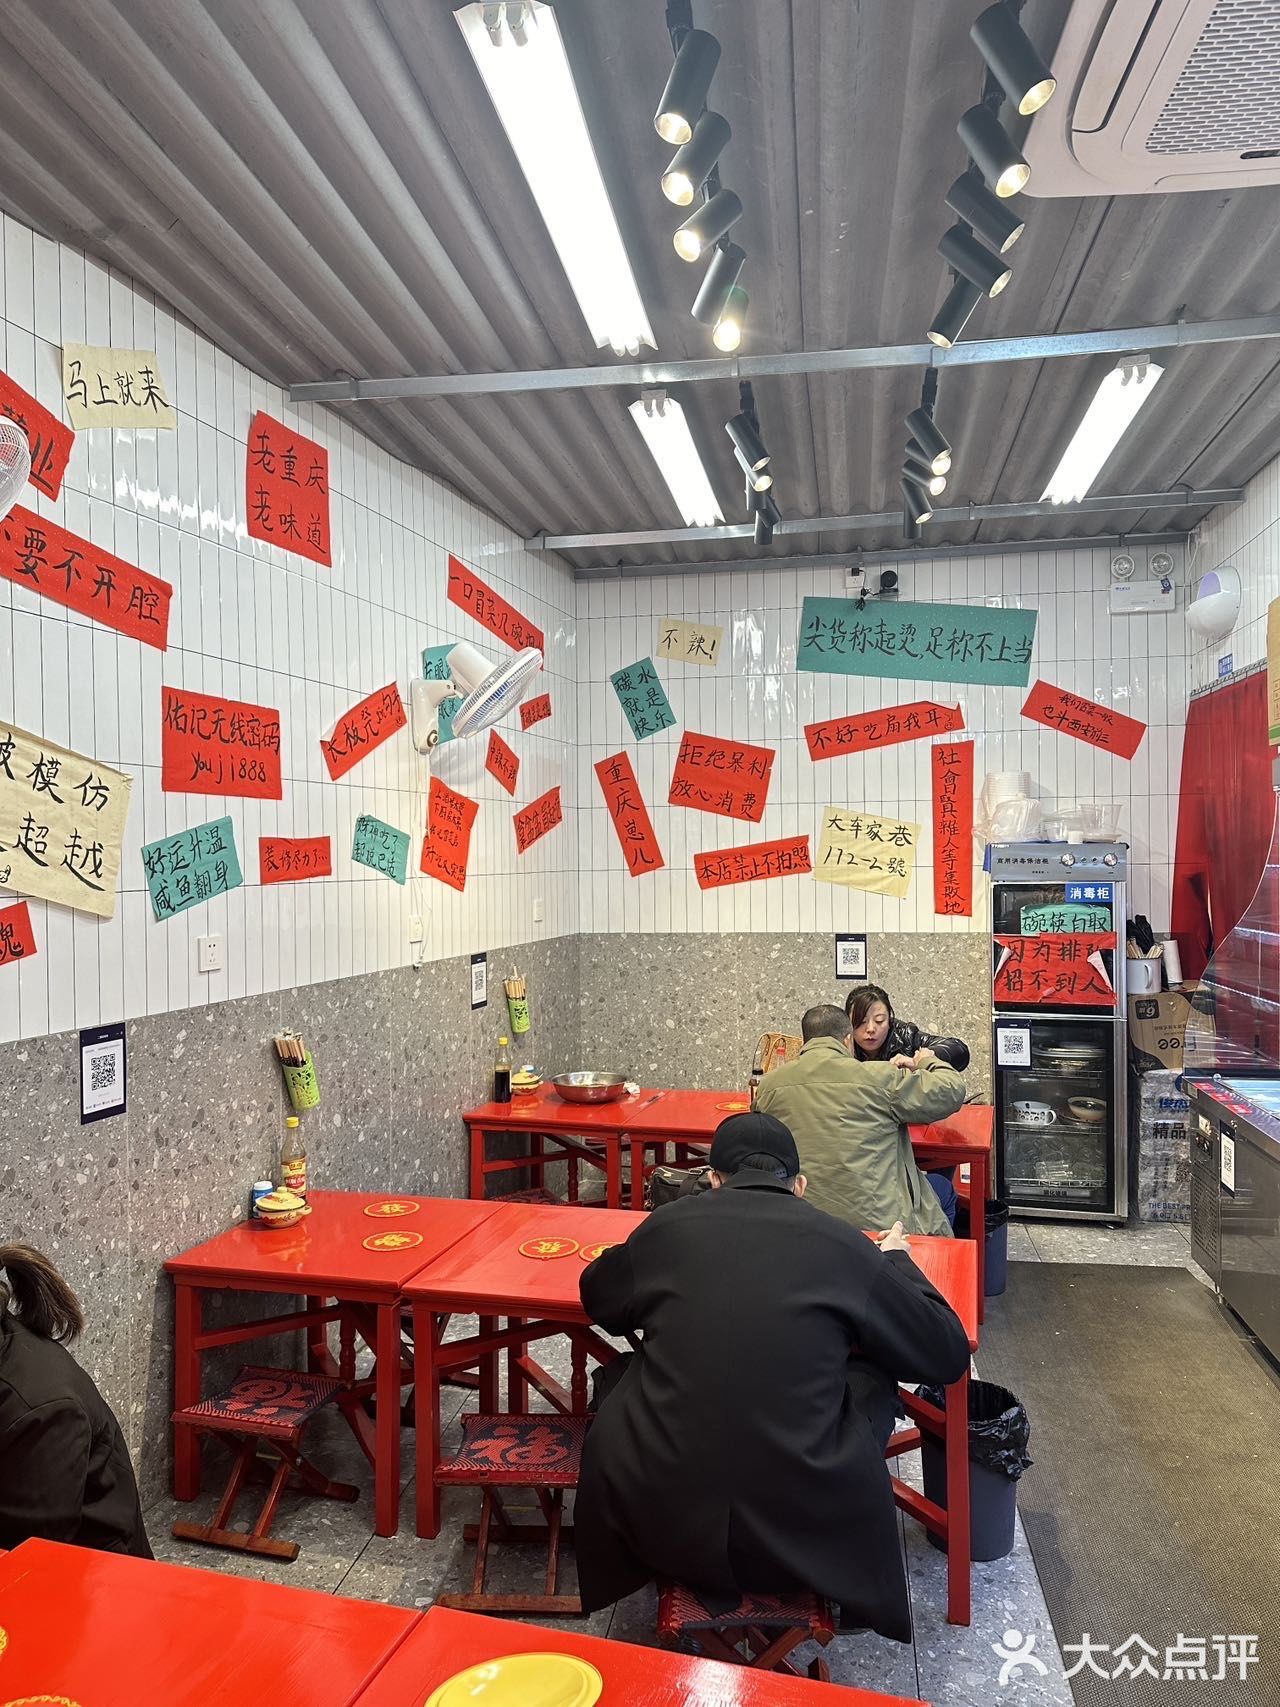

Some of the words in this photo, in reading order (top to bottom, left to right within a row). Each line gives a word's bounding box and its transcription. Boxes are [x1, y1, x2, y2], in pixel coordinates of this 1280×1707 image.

[66, 360, 170, 414] 马上就来
[250, 430, 326, 495] 老重庆
[250, 485, 327, 554] 老味道
[613, 665, 657, 693] 碳水
[621, 686, 665, 718] 就是
[165, 694, 281, 756] 佑记无线密码
[633, 710, 673, 739] 快乐
[679, 738, 768, 780] 拒绝暴利
[604, 760, 656, 867] 重庆崽儿
[670, 776, 758, 820] 放心消费
[0, 811, 106, 891] 超越
[827, 813, 913, 847] 大车家巷
[144, 825, 228, 881] 好运升温
[698, 841, 812, 883] 本店禁止不拍照
[154, 860, 229, 917] 咸鱼翻身
[1069, 886, 1110, 900] 消毒柜
[1022, 911, 1109, 934] 碗筷自取
[1003, 967, 1111, 996] 招不到人
[1152, 1121, 1187, 1140] 精品
[468, 1425, 571, 1464] 福
